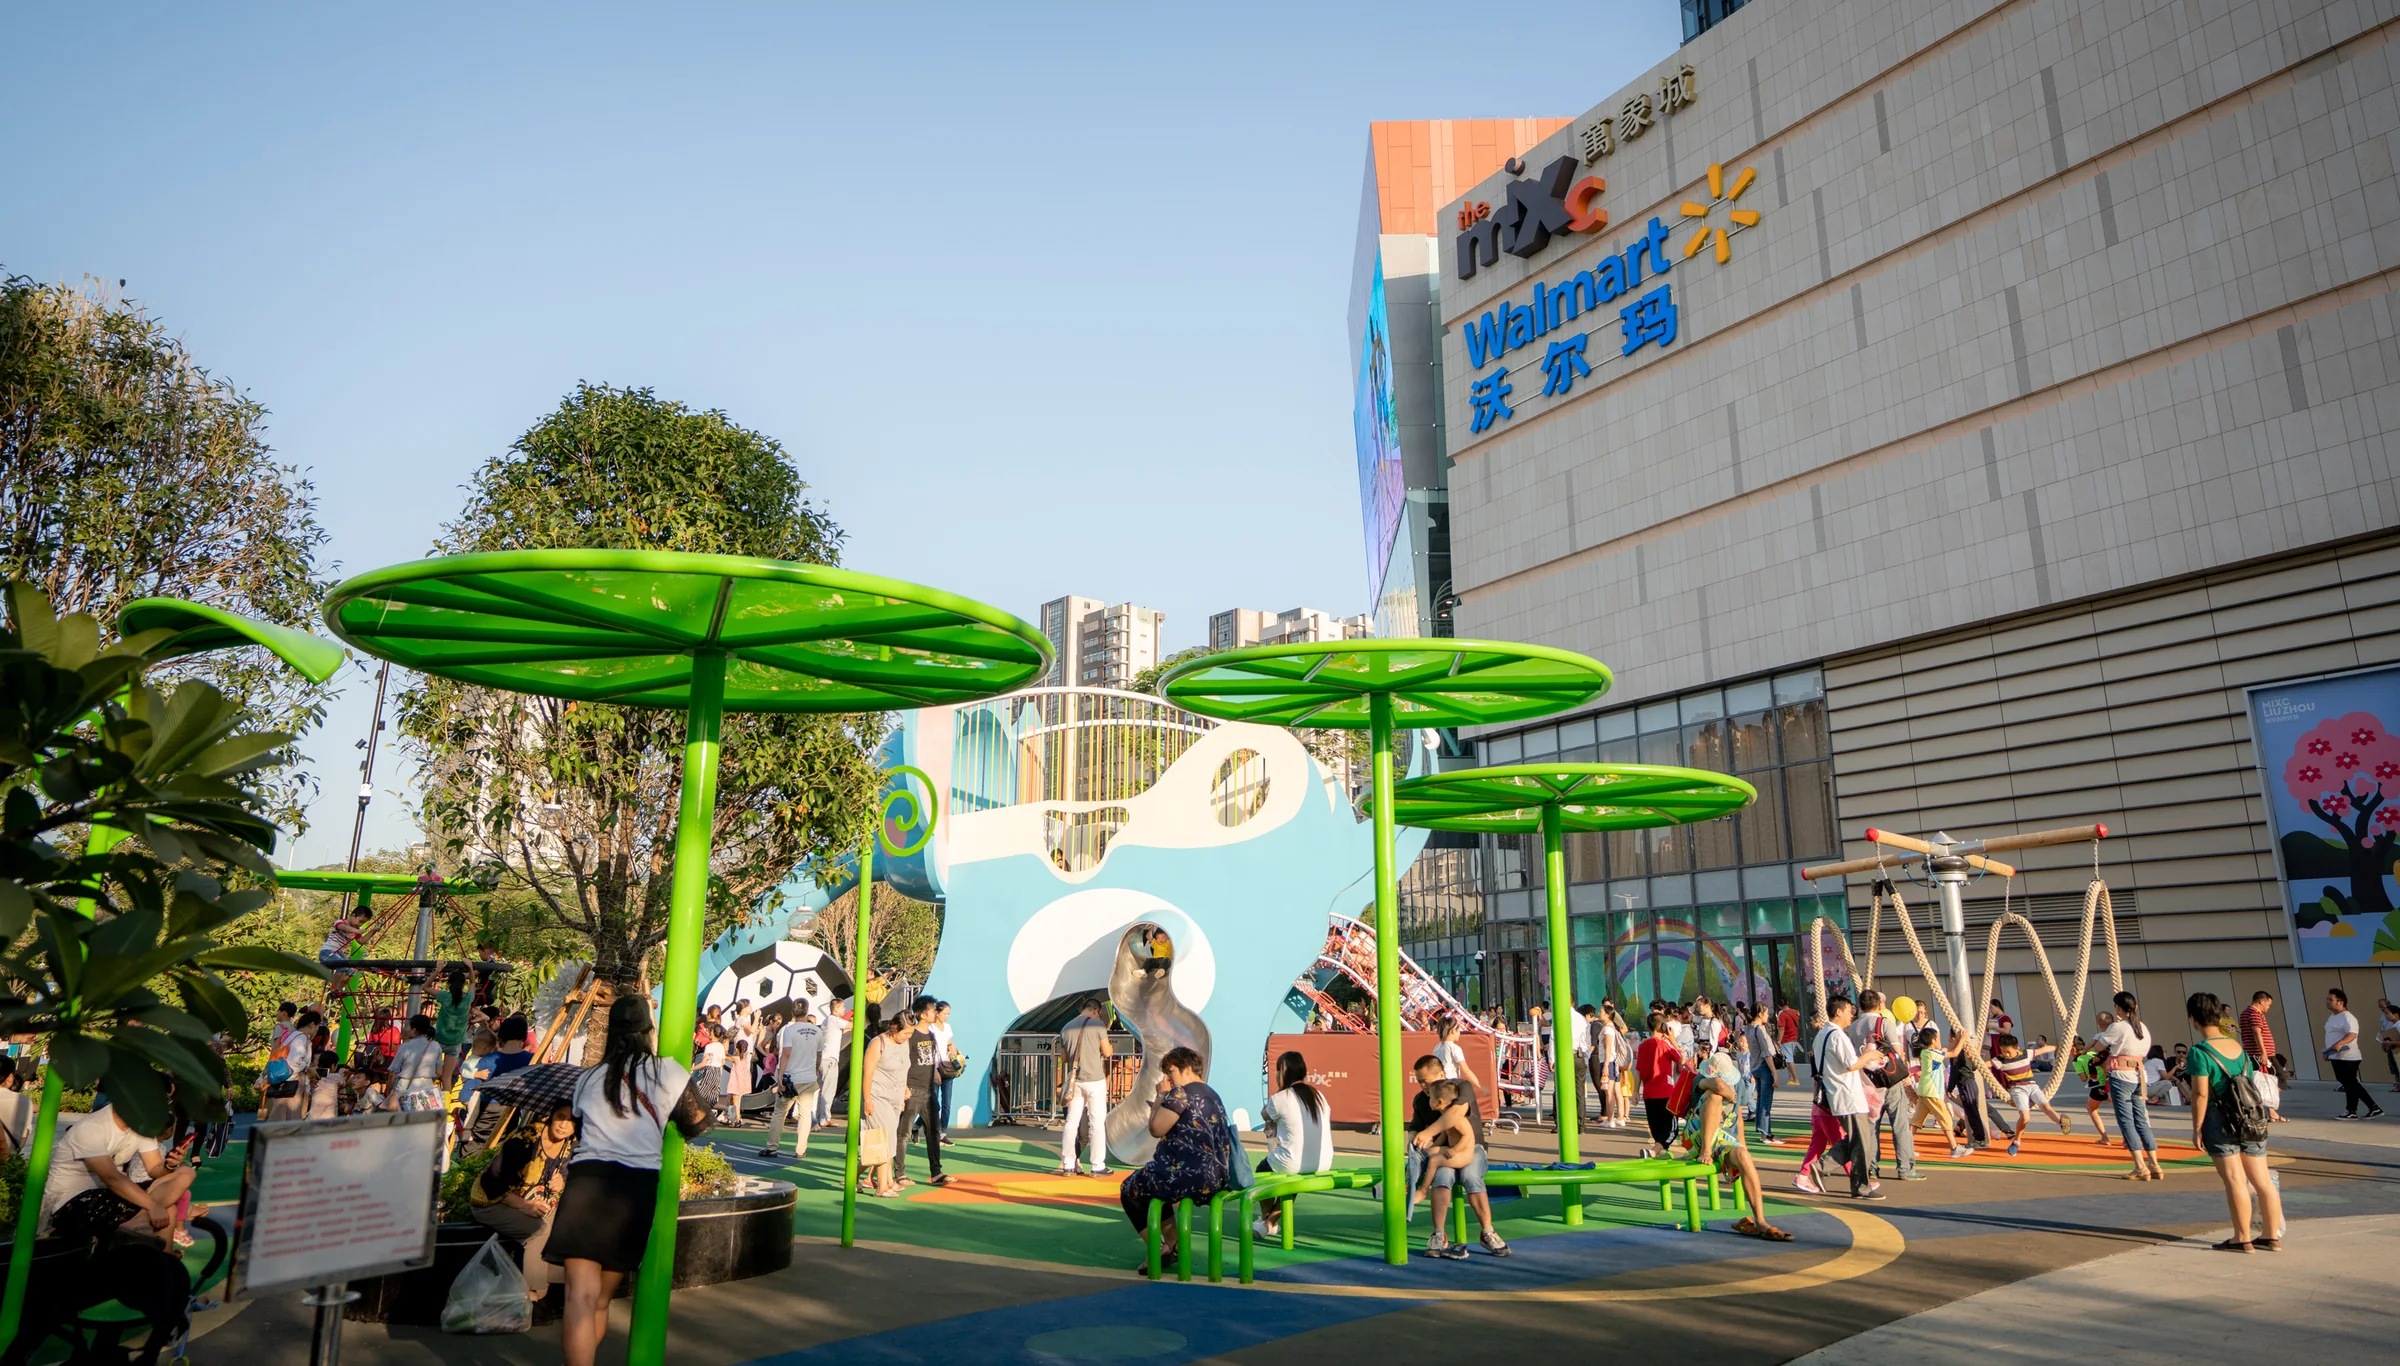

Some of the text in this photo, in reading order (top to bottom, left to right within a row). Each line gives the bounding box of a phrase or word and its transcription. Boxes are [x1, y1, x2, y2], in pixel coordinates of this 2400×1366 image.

[1580, 63, 1698, 167] 萬象城
[1457, 200, 1491, 231] the
[1463, 216, 1672, 369] Walmart
[1468, 283, 1678, 434] 沃尔玛
[2261, 697, 2291, 709] MIXC
[2263, 702, 2316, 717] LIUZHOU
